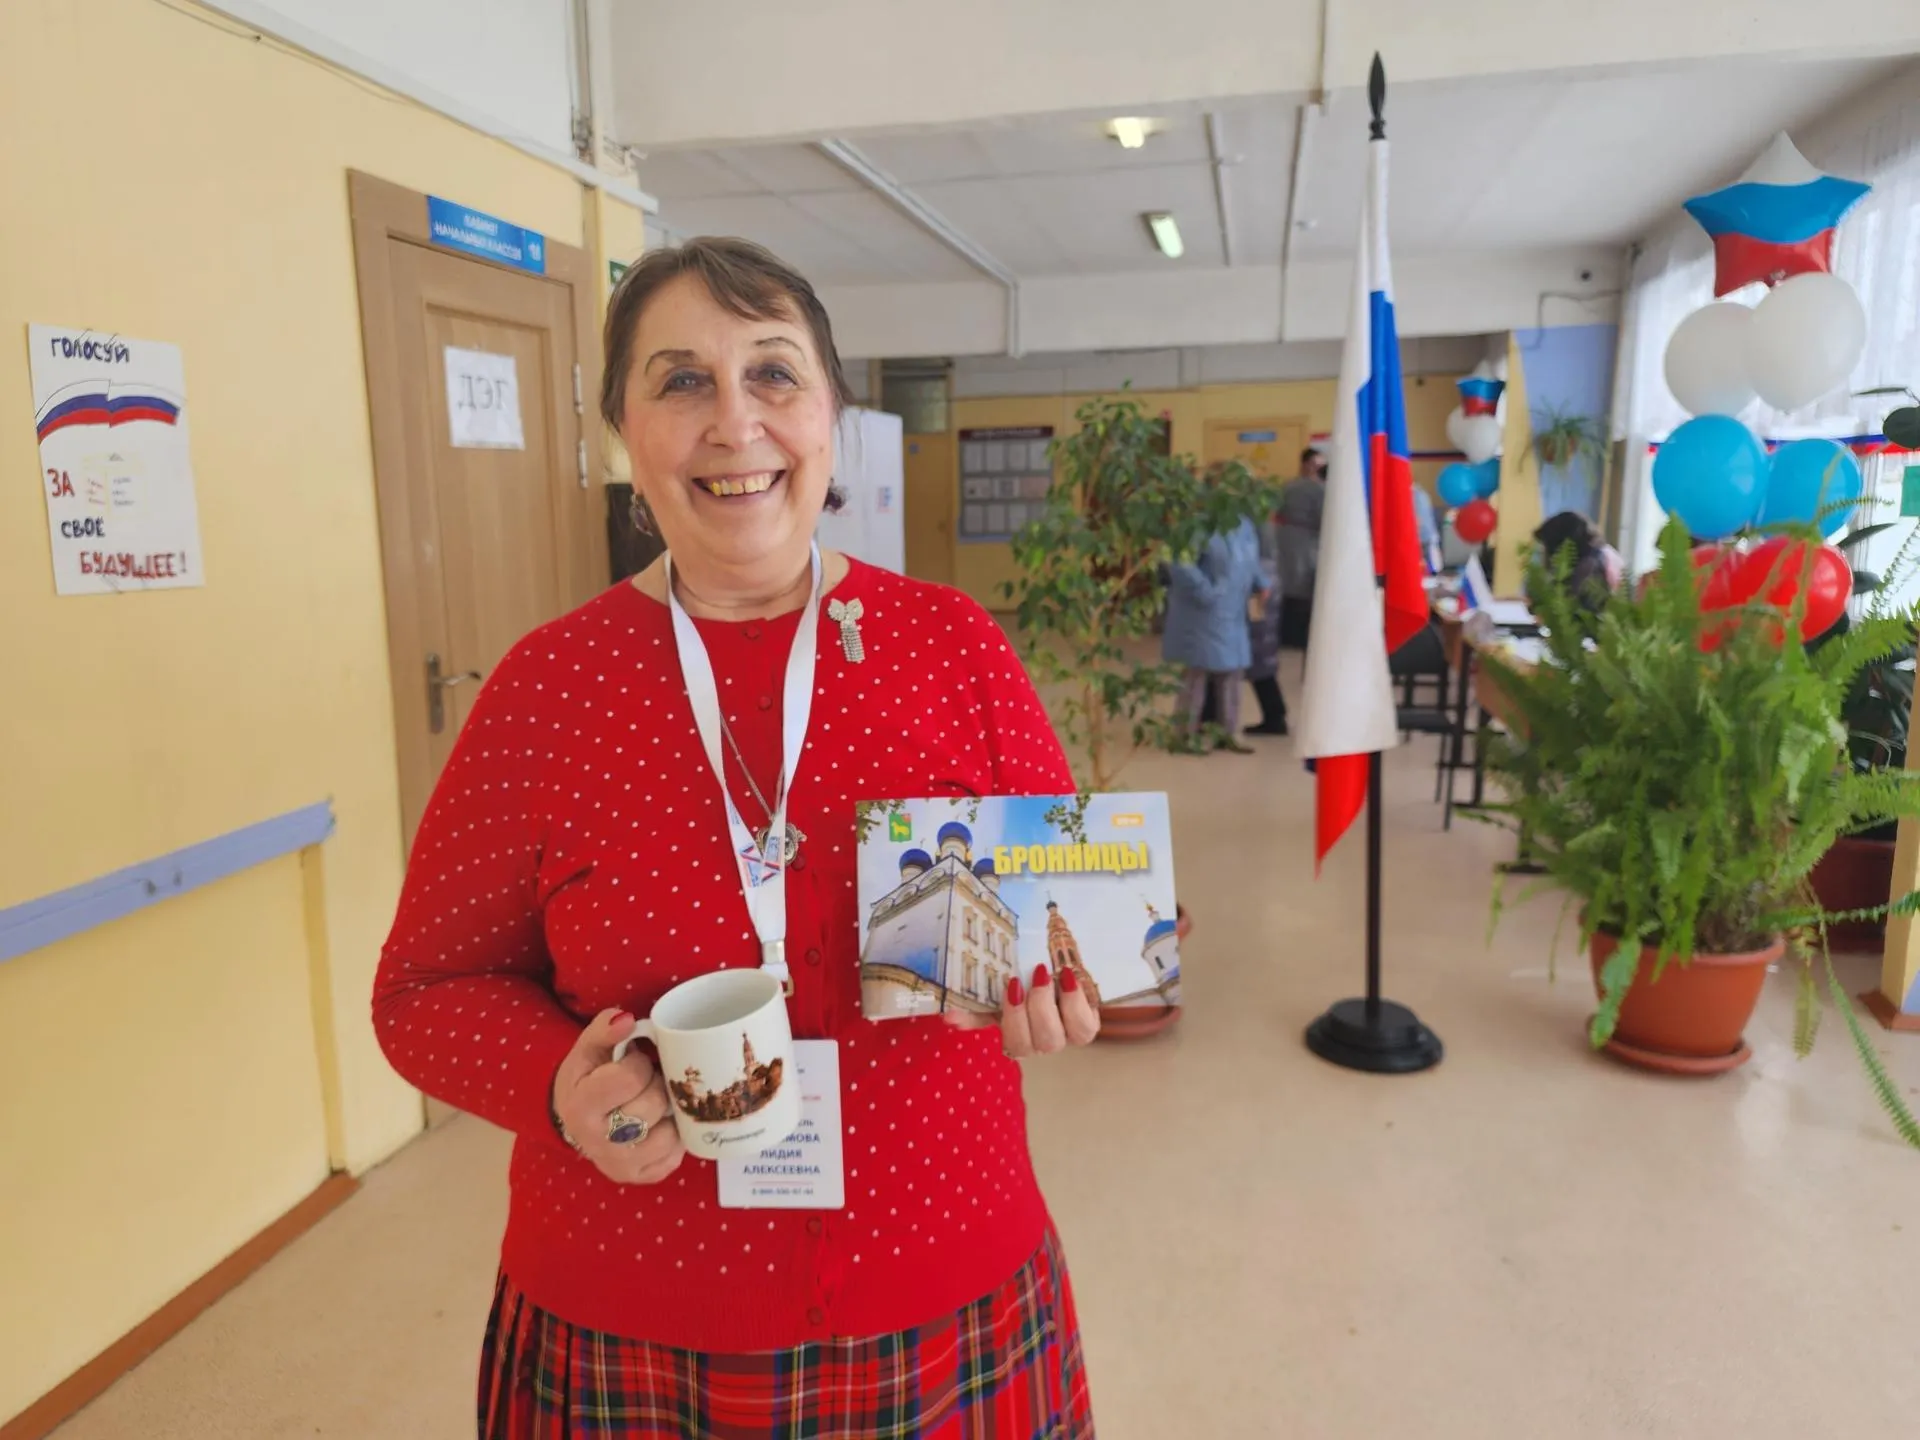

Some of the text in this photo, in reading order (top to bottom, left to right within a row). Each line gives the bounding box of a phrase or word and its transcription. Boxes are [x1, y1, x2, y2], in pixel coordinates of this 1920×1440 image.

[51, 337, 129, 363] ГОЛОСУЙ
[457, 374, 509, 411] ДЭГ
[47, 468, 75, 498] ЗА
[993, 842, 1148, 875] БРОННИЦЫ
[760, 1149, 803, 1160] ЛИДИЯ
[743, 1164, 821, 1175] АЛЕКСЕЕВНА
